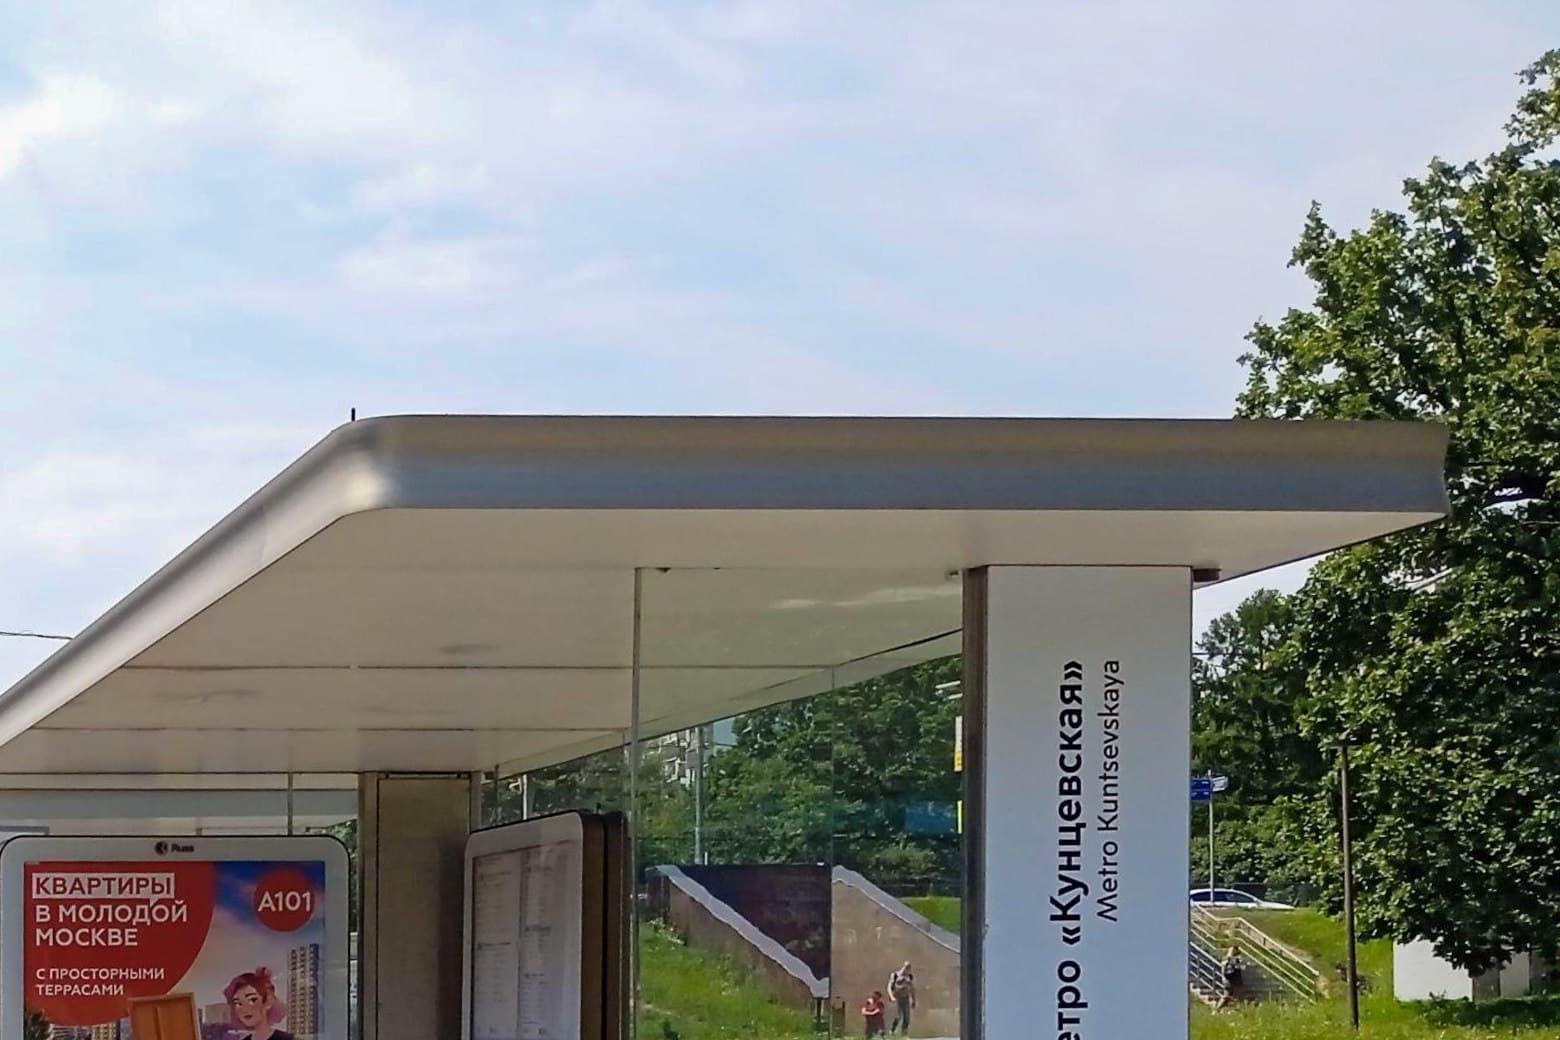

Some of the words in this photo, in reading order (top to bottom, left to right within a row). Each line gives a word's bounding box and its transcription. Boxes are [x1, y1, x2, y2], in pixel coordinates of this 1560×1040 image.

[1097, 660, 1125, 832] Kuntsevskaya
[1050, 660, 1089, 945] «Кунцевская»
[36, 877, 171, 895] КВАРТИРЫ
[1097, 841, 1118, 922] Metro
[36, 905, 51, 922] В
[58, 900, 188, 926] МОЛОДОЙ
[36, 928, 138, 946] МОСКВЕ
[36, 968, 46, 980] С
[49, 968, 165, 980] ПРОСТОРНЫМИ
[36, 984, 125, 996] ТЕРРАСАМИ
